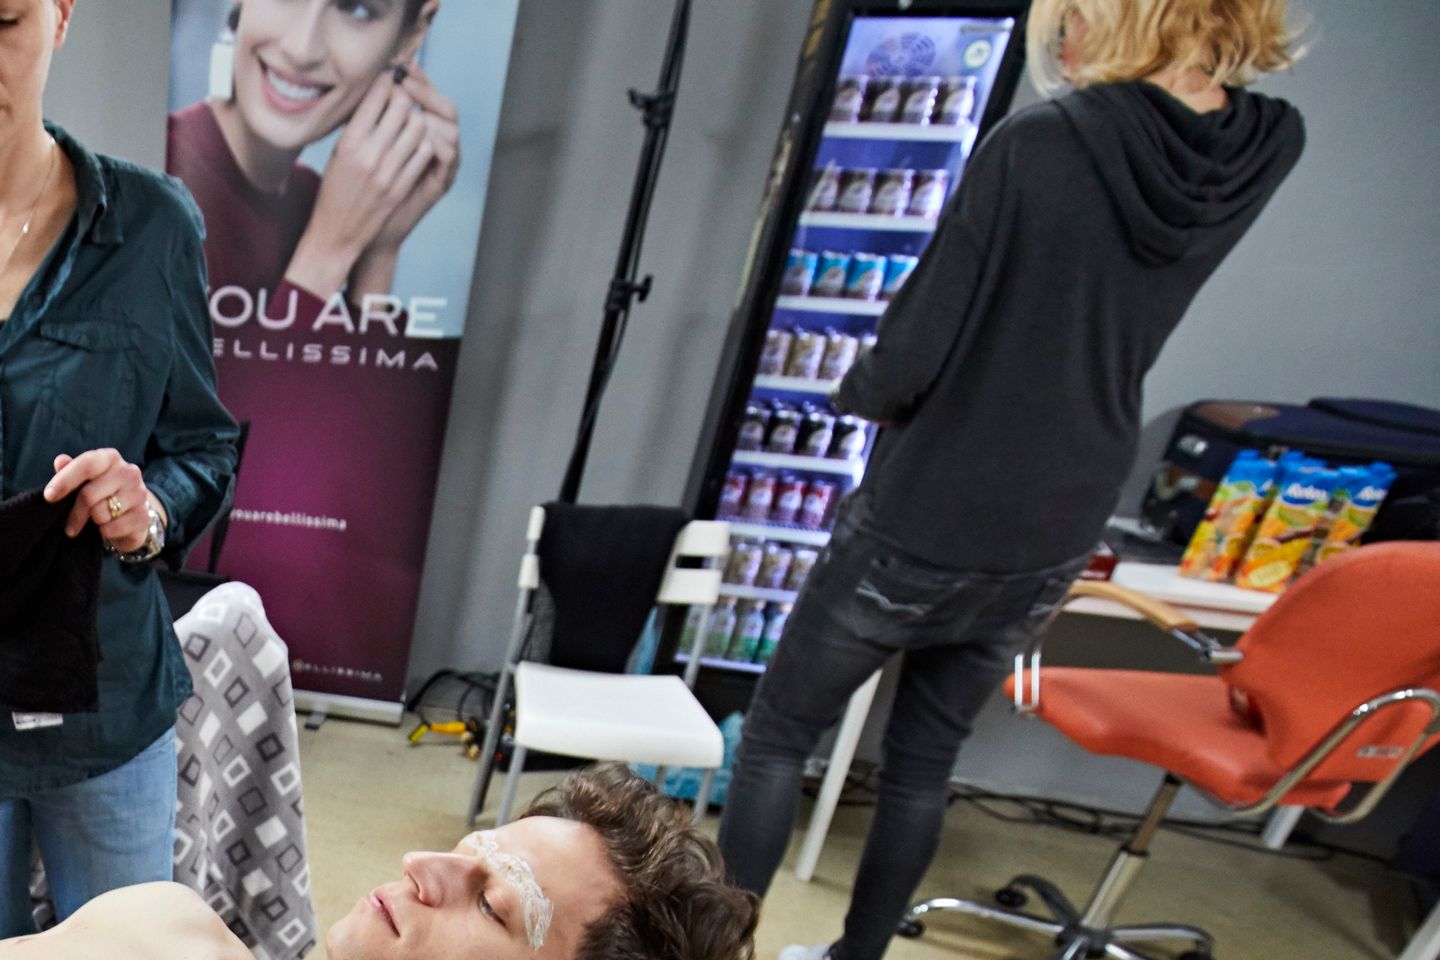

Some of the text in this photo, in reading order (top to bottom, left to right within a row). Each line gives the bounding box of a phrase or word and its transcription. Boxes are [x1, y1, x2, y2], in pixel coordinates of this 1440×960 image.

[207, 284, 448, 338] OU ARE
[212, 337, 439, 372] ELLISSIMA
